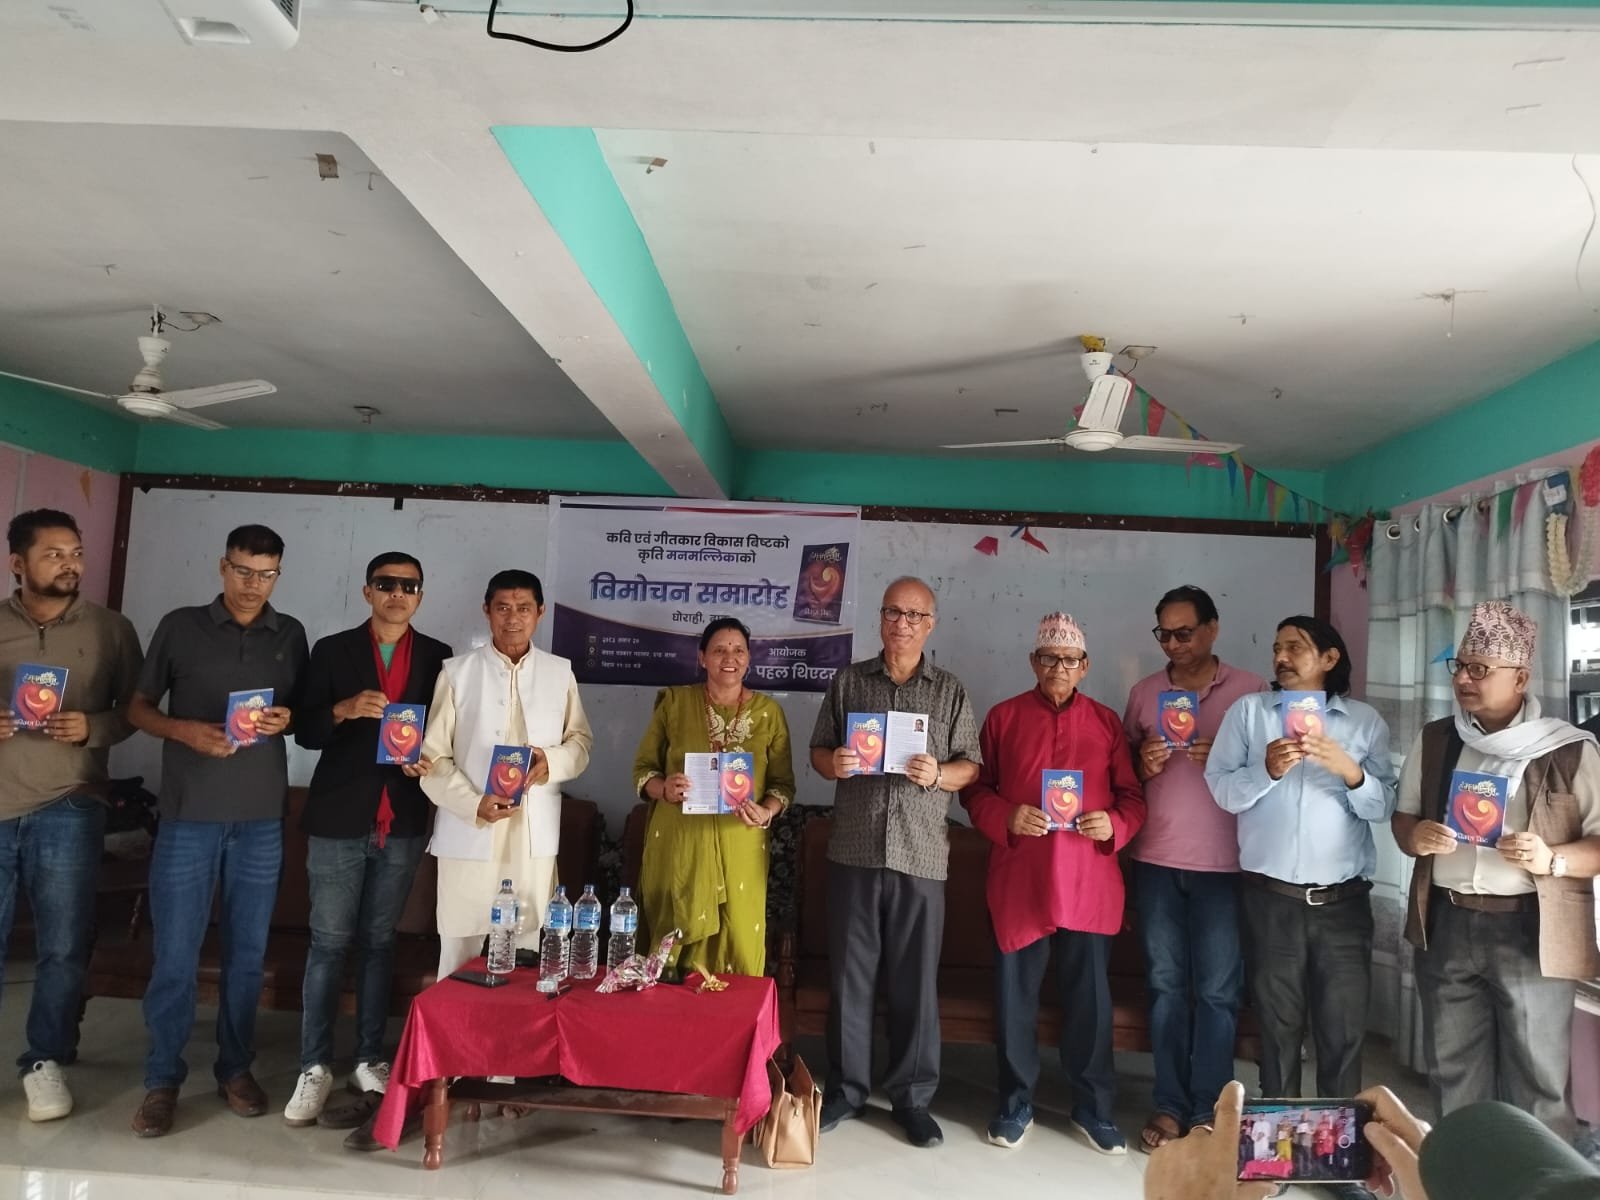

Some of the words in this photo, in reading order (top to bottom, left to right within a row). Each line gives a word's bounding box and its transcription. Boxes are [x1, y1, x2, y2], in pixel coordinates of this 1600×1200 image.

[606, 529, 632, 543] कवि
[634, 530, 651, 544] एवं
[653, 531, 702, 546] गीतकार
[703, 532, 744, 547] विकास
[637, 546, 664, 564] कृति
[666, 547, 756, 563] मनमल्लिकाको
[590, 572, 692, 603] विमोचन
[696, 578, 790, 609] समारोह
[768, 645, 808, 657] आयोजक
[755, 665, 790, 680] पहल
[792, 662, 838, 680] थिएटर
